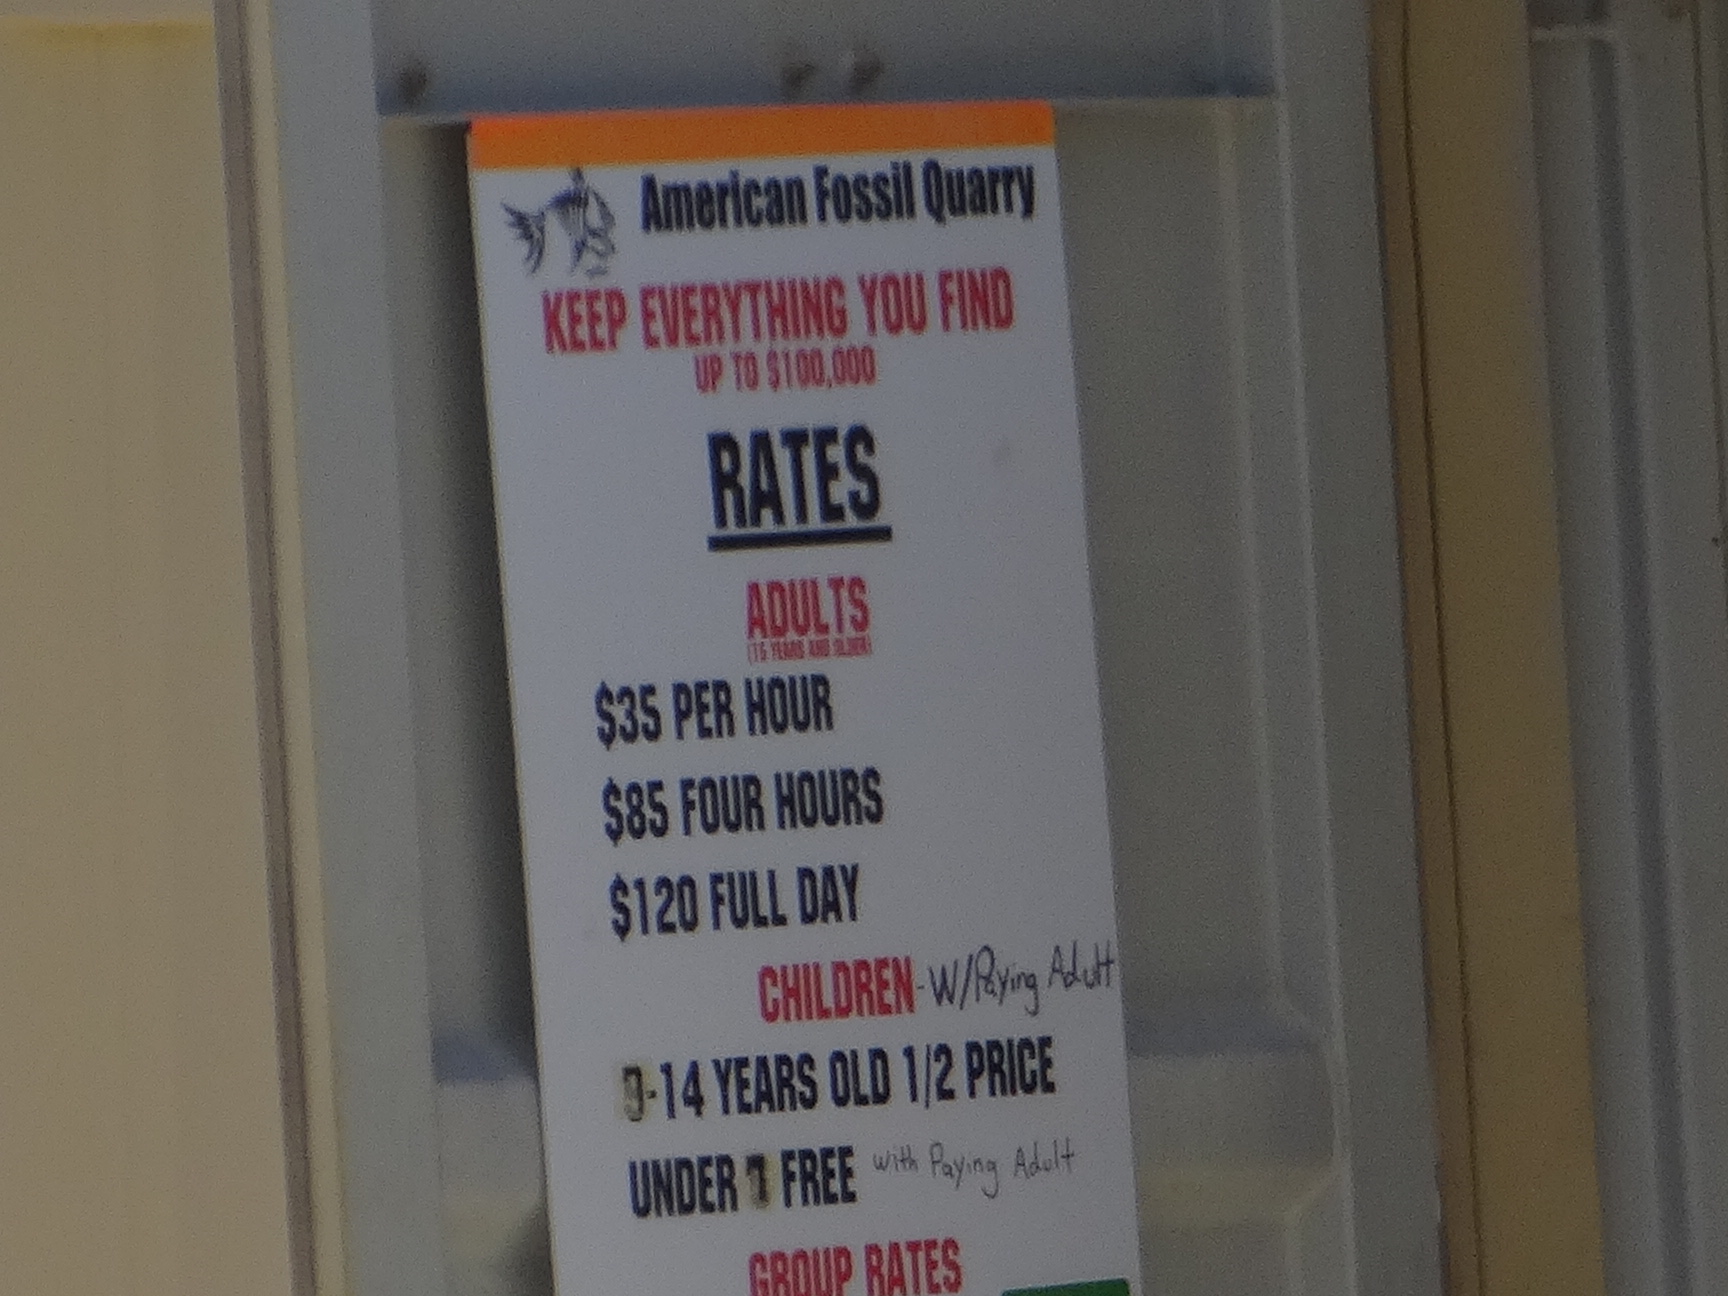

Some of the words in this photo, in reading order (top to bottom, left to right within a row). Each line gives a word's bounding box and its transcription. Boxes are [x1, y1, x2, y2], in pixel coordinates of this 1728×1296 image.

[640, 172, 807, 233] American
[814, 162, 915, 225] Fossil
[923, 159, 1035, 224] Quarry
[542, 287, 626, 354] KEEP
[640, 276, 848, 350] EVERYTHING
[857, 270, 927, 337] YOU
[938, 266, 1014, 331] FIND
[694, 352, 722, 394] UP
[734, 351, 759, 390] TO
[766, 345, 876, 391] $100,000
[707, 424, 881, 528] RATES
[747, 576, 870, 638] ADULTS
[594, 681, 662, 750] $35
[673, 679, 735, 739] PER
[744, 673, 834, 737] HOUR
[602, 777, 669, 846] $85
[680, 774, 765, 835] FOUR
[773, 766, 884, 831] HOURS
[609, 872, 698, 942] $120
[709, 868, 787, 930] FULL
[796, 863, 860, 924] DAY
[758, 955, 916, 1024] CHILDREN
[1047, 939, 1116, 990] Adult
[713, 1051, 818, 1116] YEARS
[829, 1047, 892, 1107] OLD
[903, 1042, 956, 1110] 1/2
[965, 1035, 1057, 1100] PRICE
[629, 1154, 738, 1220] UNDER
[781, 1145, 858, 1209] FREE
[872, 1145, 919, 1174] with
[930, 1140, 999, 1199] Paying
[1012, 1136, 1076, 1180] Adult
